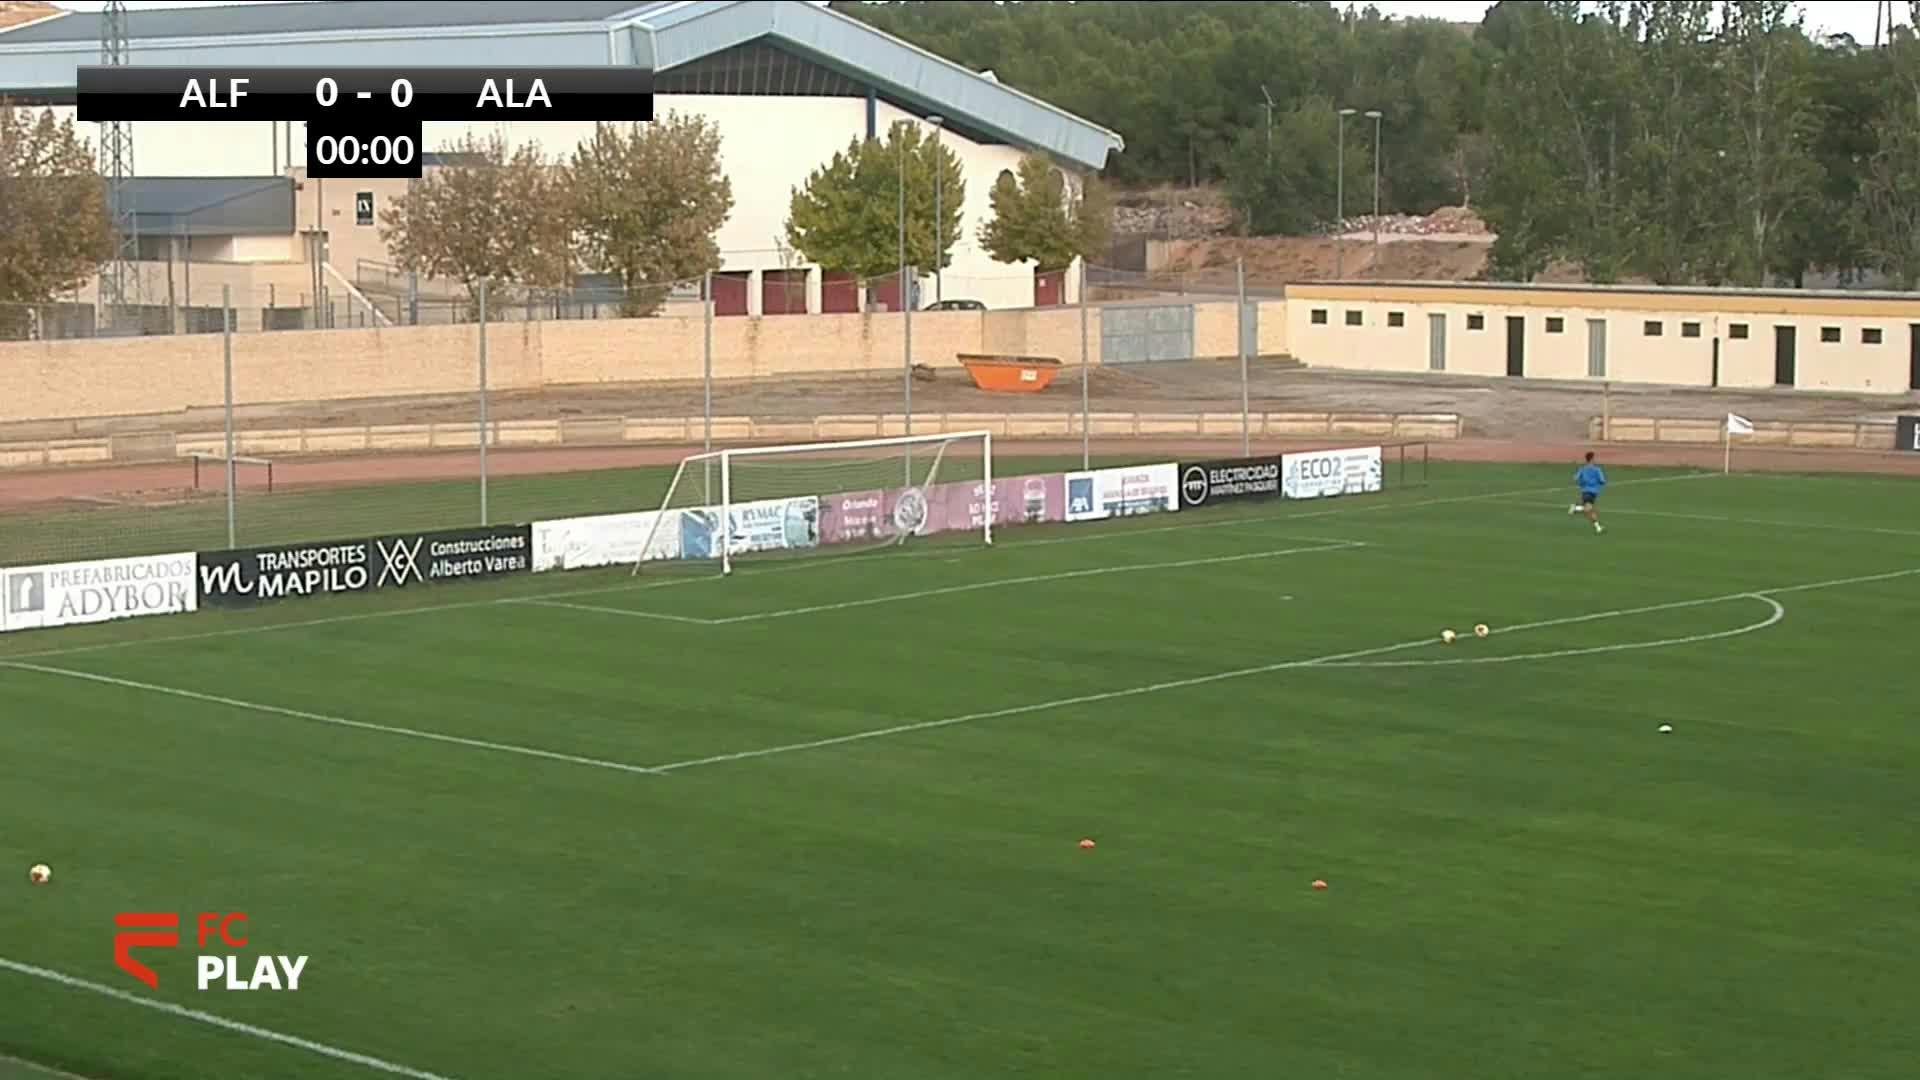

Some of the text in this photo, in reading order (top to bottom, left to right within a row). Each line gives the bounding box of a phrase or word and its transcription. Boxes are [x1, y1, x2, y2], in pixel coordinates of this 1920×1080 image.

[1210, 464, 1278, 484] ELECTRICIDAD
[1301, 456, 1342, 480] ECO2
[256, 544, 366, 572] TRANSPORTES
[430, 535, 525, 557] Construcciones
[50, 559, 192, 589] PREFABRICADOS
[430, 555, 525, 578] Alberto Varea
[258, 566, 368, 598] MAPILO
[58, 581, 187, 618] ADYBOR
